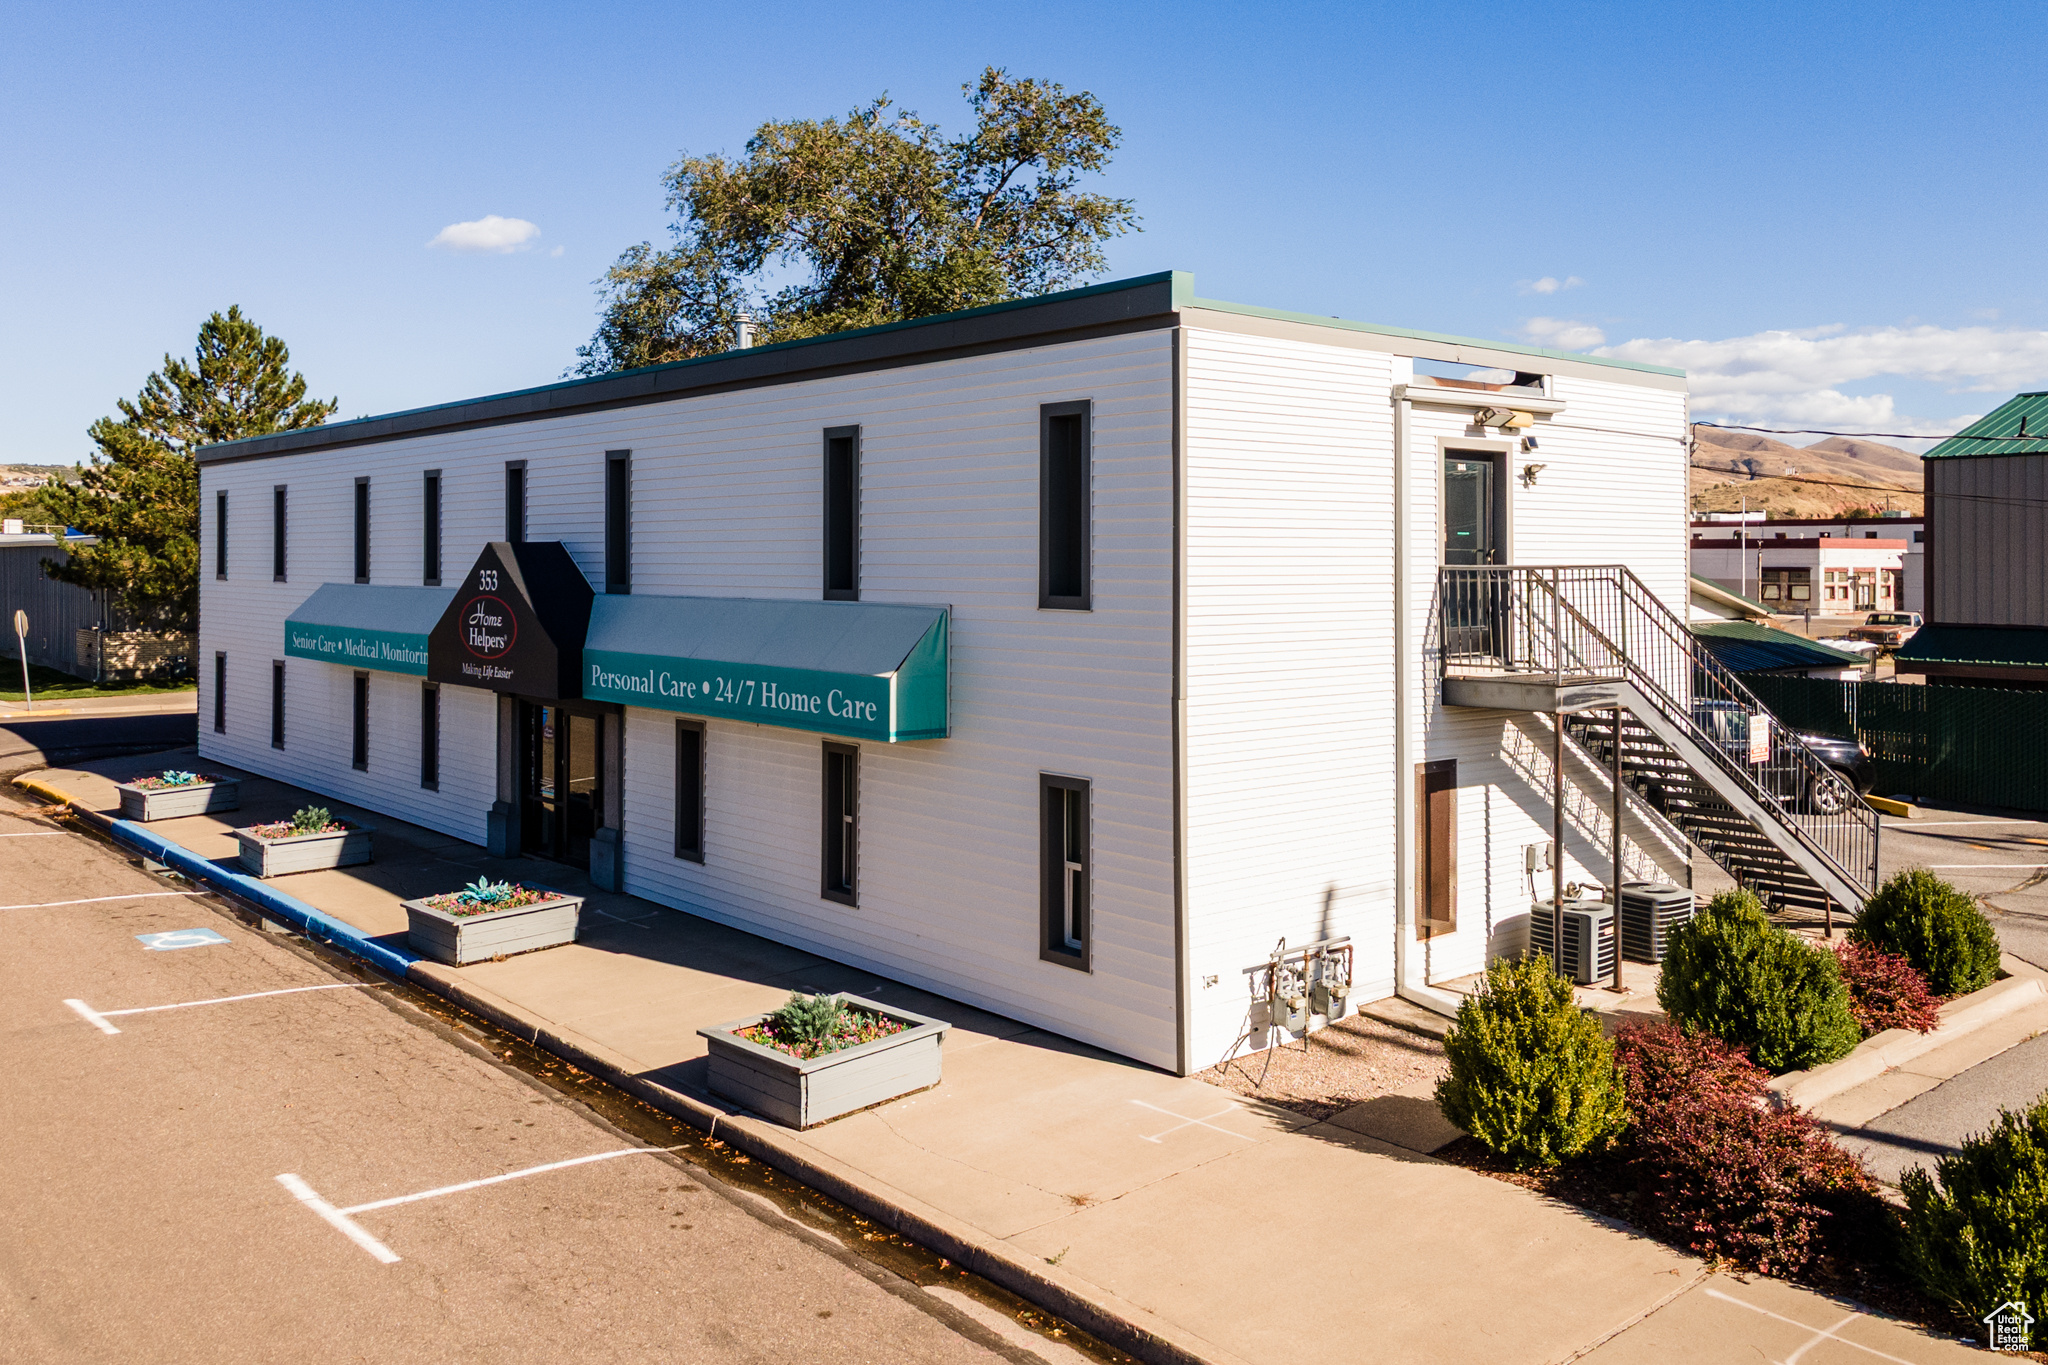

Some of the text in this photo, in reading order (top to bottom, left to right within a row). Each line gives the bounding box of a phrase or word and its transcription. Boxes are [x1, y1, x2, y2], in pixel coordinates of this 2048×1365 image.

[479, 570, 498, 591] 353
[469, 601, 503, 627] Home
[292, 632, 428, 665] Senior Care Medical Monitorin
[462, 663, 482, 679] Making
[483, 665, 494, 680] Life
[592, 664, 877, 721] Personal Care 24/7 Home Care
